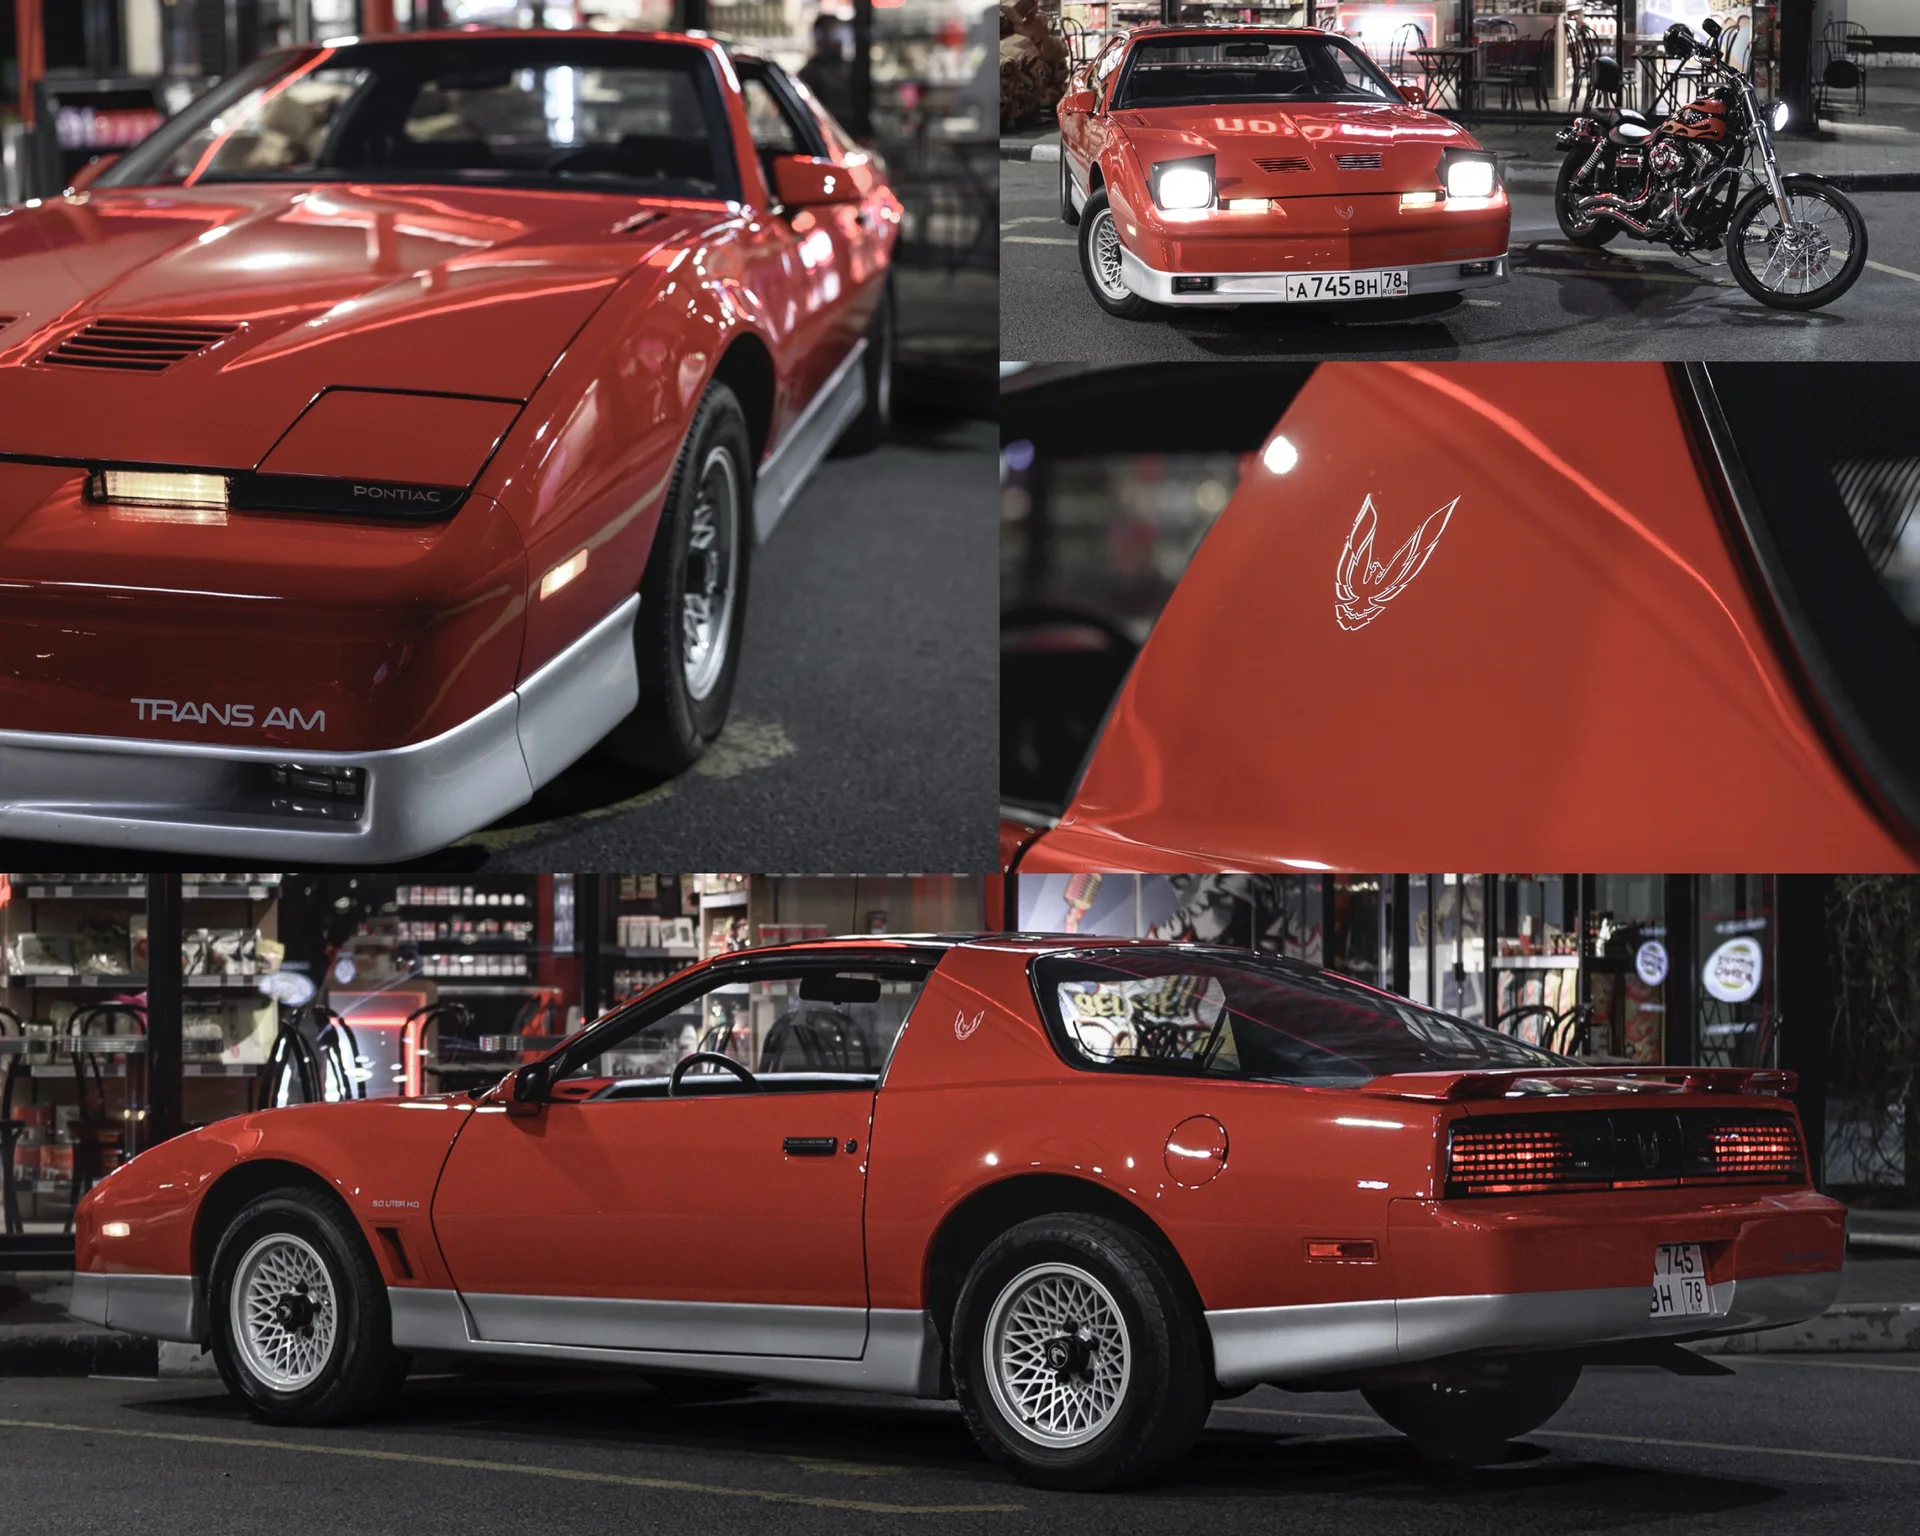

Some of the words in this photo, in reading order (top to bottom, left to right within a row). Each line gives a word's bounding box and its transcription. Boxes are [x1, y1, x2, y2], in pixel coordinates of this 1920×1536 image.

[1383, 272, 1402, 288] 78
[353, 485, 440, 502] PONTIAC
[130, 698, 254, 727] TRANS
[261, 706, 325, 732] AM
[385, 1200, 406, 1208] LITER
[1685, 1281, 1703, 1303] 78
